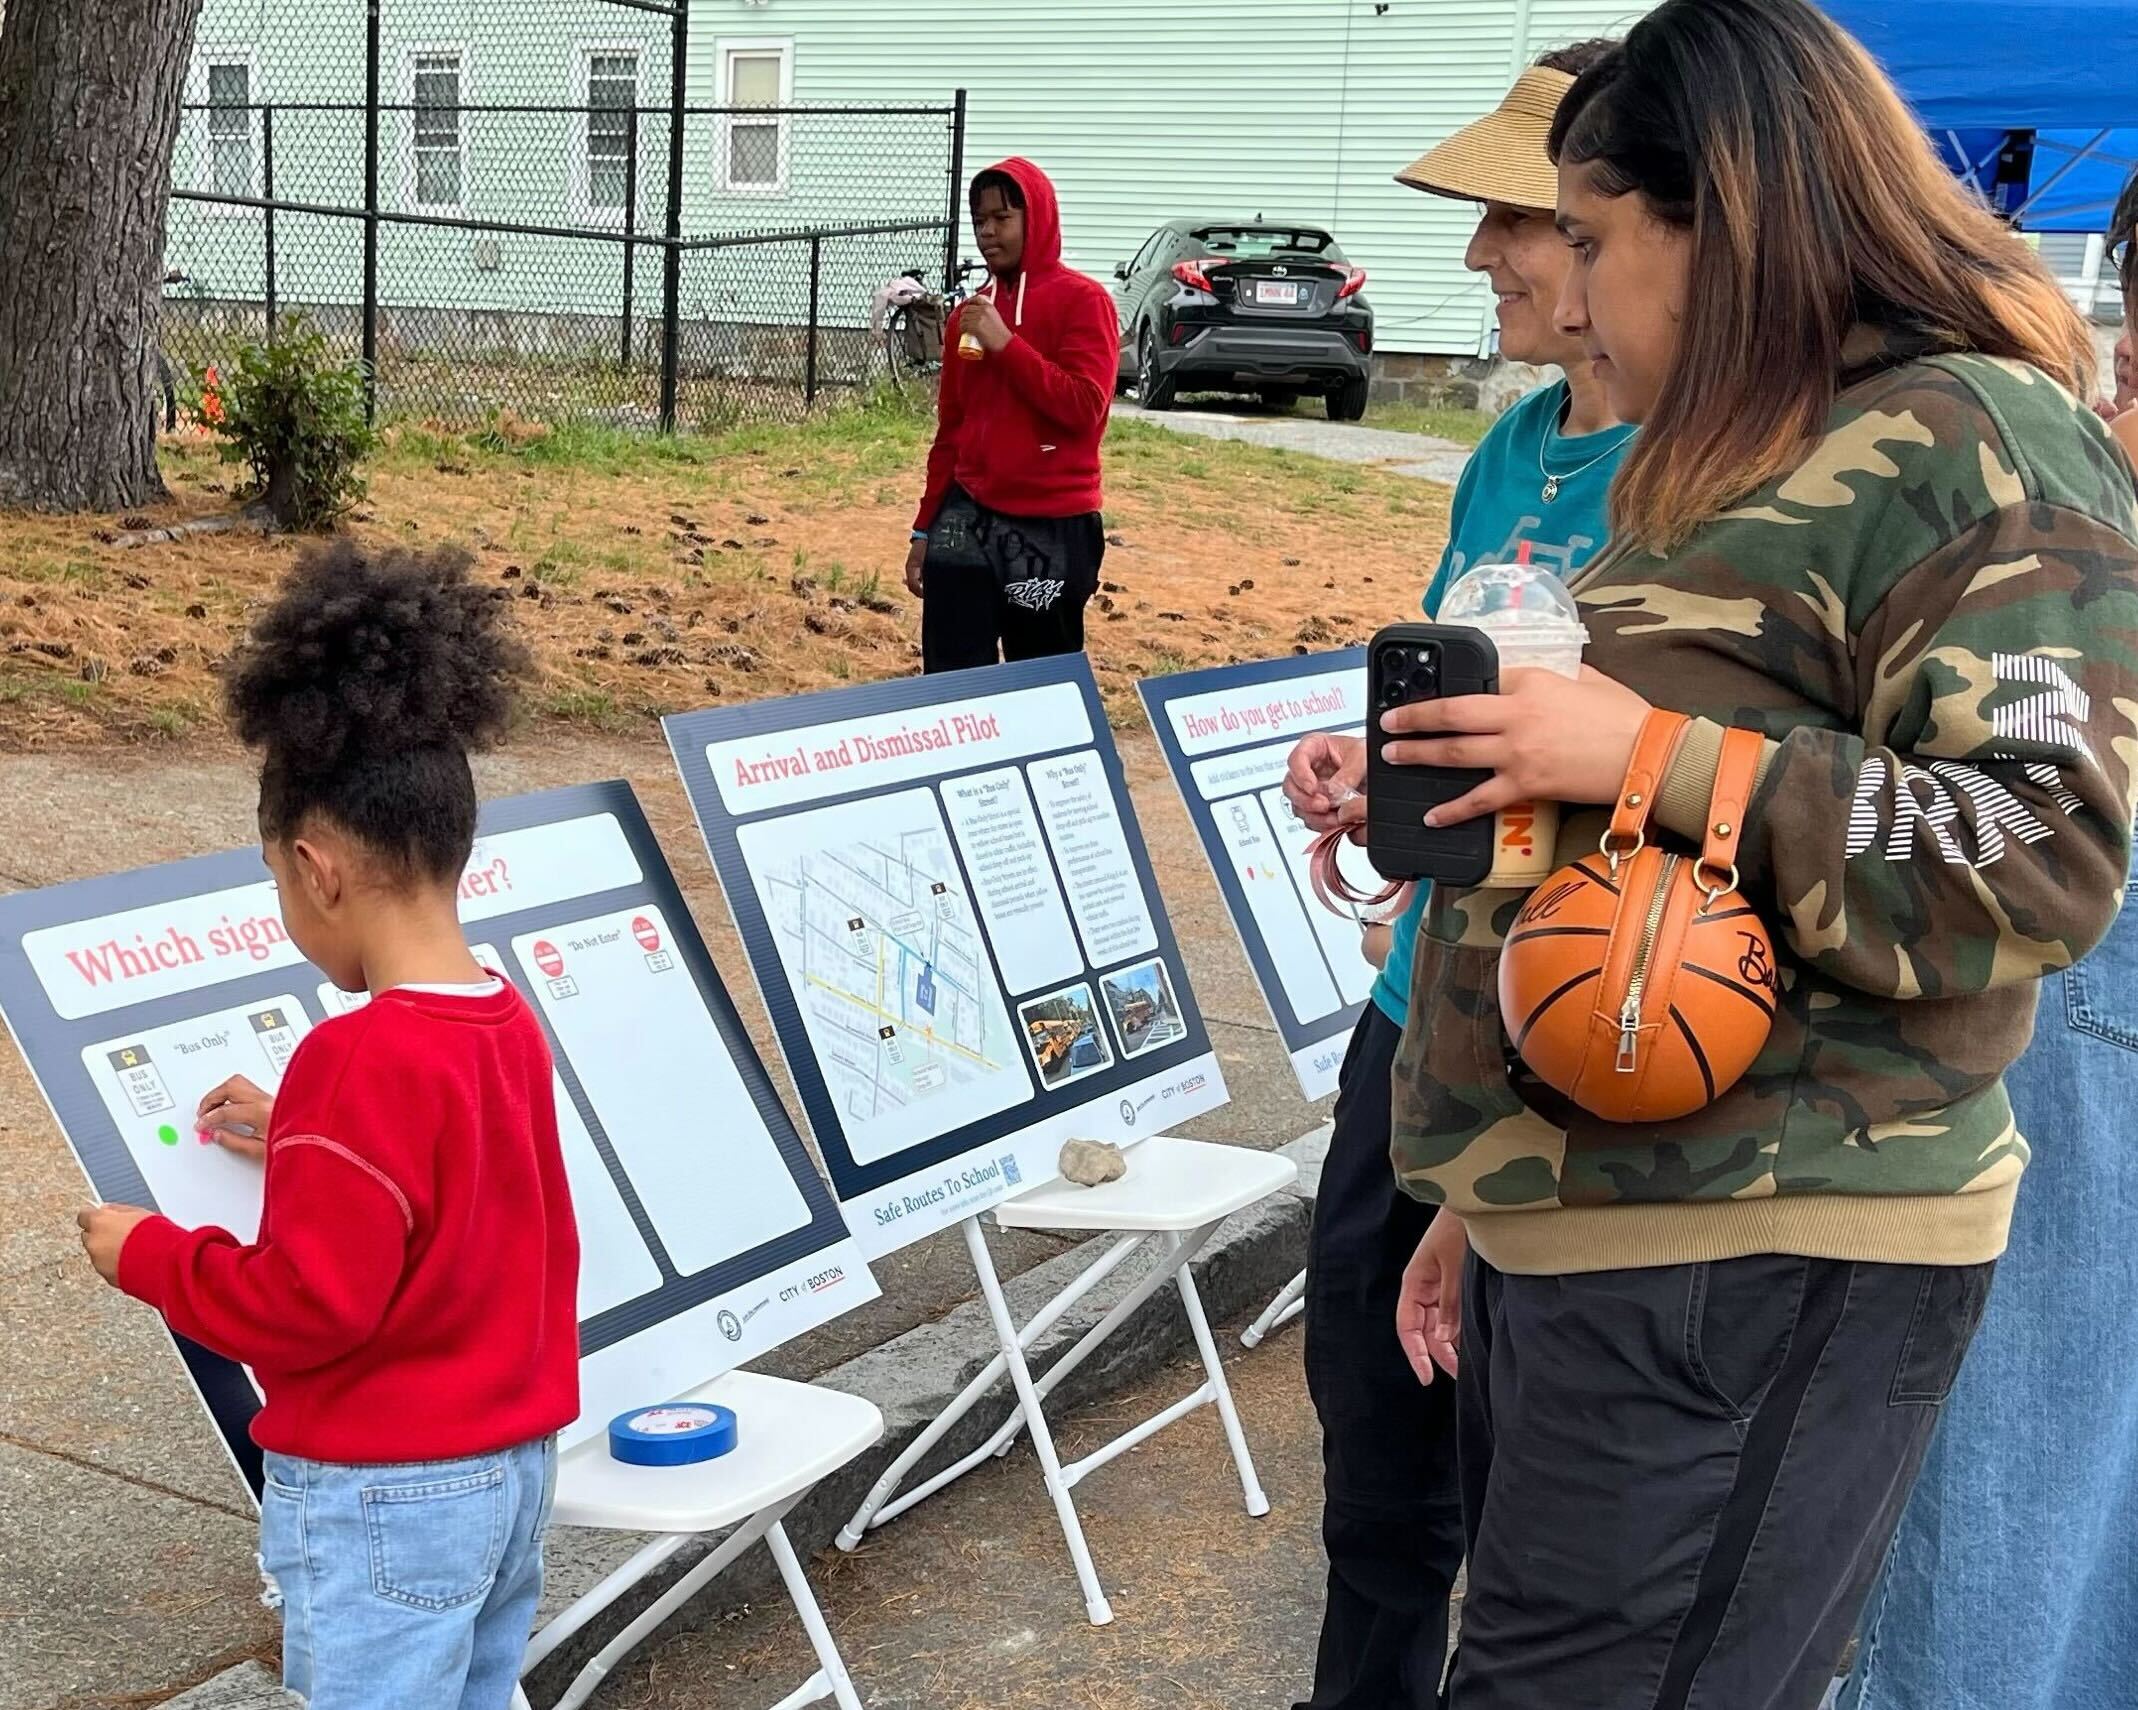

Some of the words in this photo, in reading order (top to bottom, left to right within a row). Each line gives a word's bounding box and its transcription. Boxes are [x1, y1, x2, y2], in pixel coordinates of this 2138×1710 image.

[1182, 712, 1218, 738] How
[1220, 706, 1240, 731] do
[1239, 708, 1266, 735] you
[1266, 699, 1288, 730] get
[1287, 698, 1302, 718] to
[1302, 686, 1346, 717] school?
[735, 747, 811, 787] Arrival
[814, 739, 853, 771] and
[852, 719, 952, 763] Dismissal
[951, 713, 1001, 744] Pilot
[65, 926, 205, 987] Which
[208, 915, 288, 961] sign
[272, 1042, 292, 1055] ONLY
[1313, 1054, 1332, 1073] Safe
[129, 1069, 148, 1082] BUS
[132, 1080, 156, 1094] ONLY
[1162, 1086, 1175, 1099] CITY
[1181, 1074, 1205, 1091] BOSTON
[874, 1200, 903, 1226] Safe
[902, 1184, 946, 1214] Routes
[944, 1178, 962, 1196] To
[962, 1160, 1000, 1188] School
[779, 1285, 800, 1302] CITY
[808, 1266, 844, 1289] BOSTON
